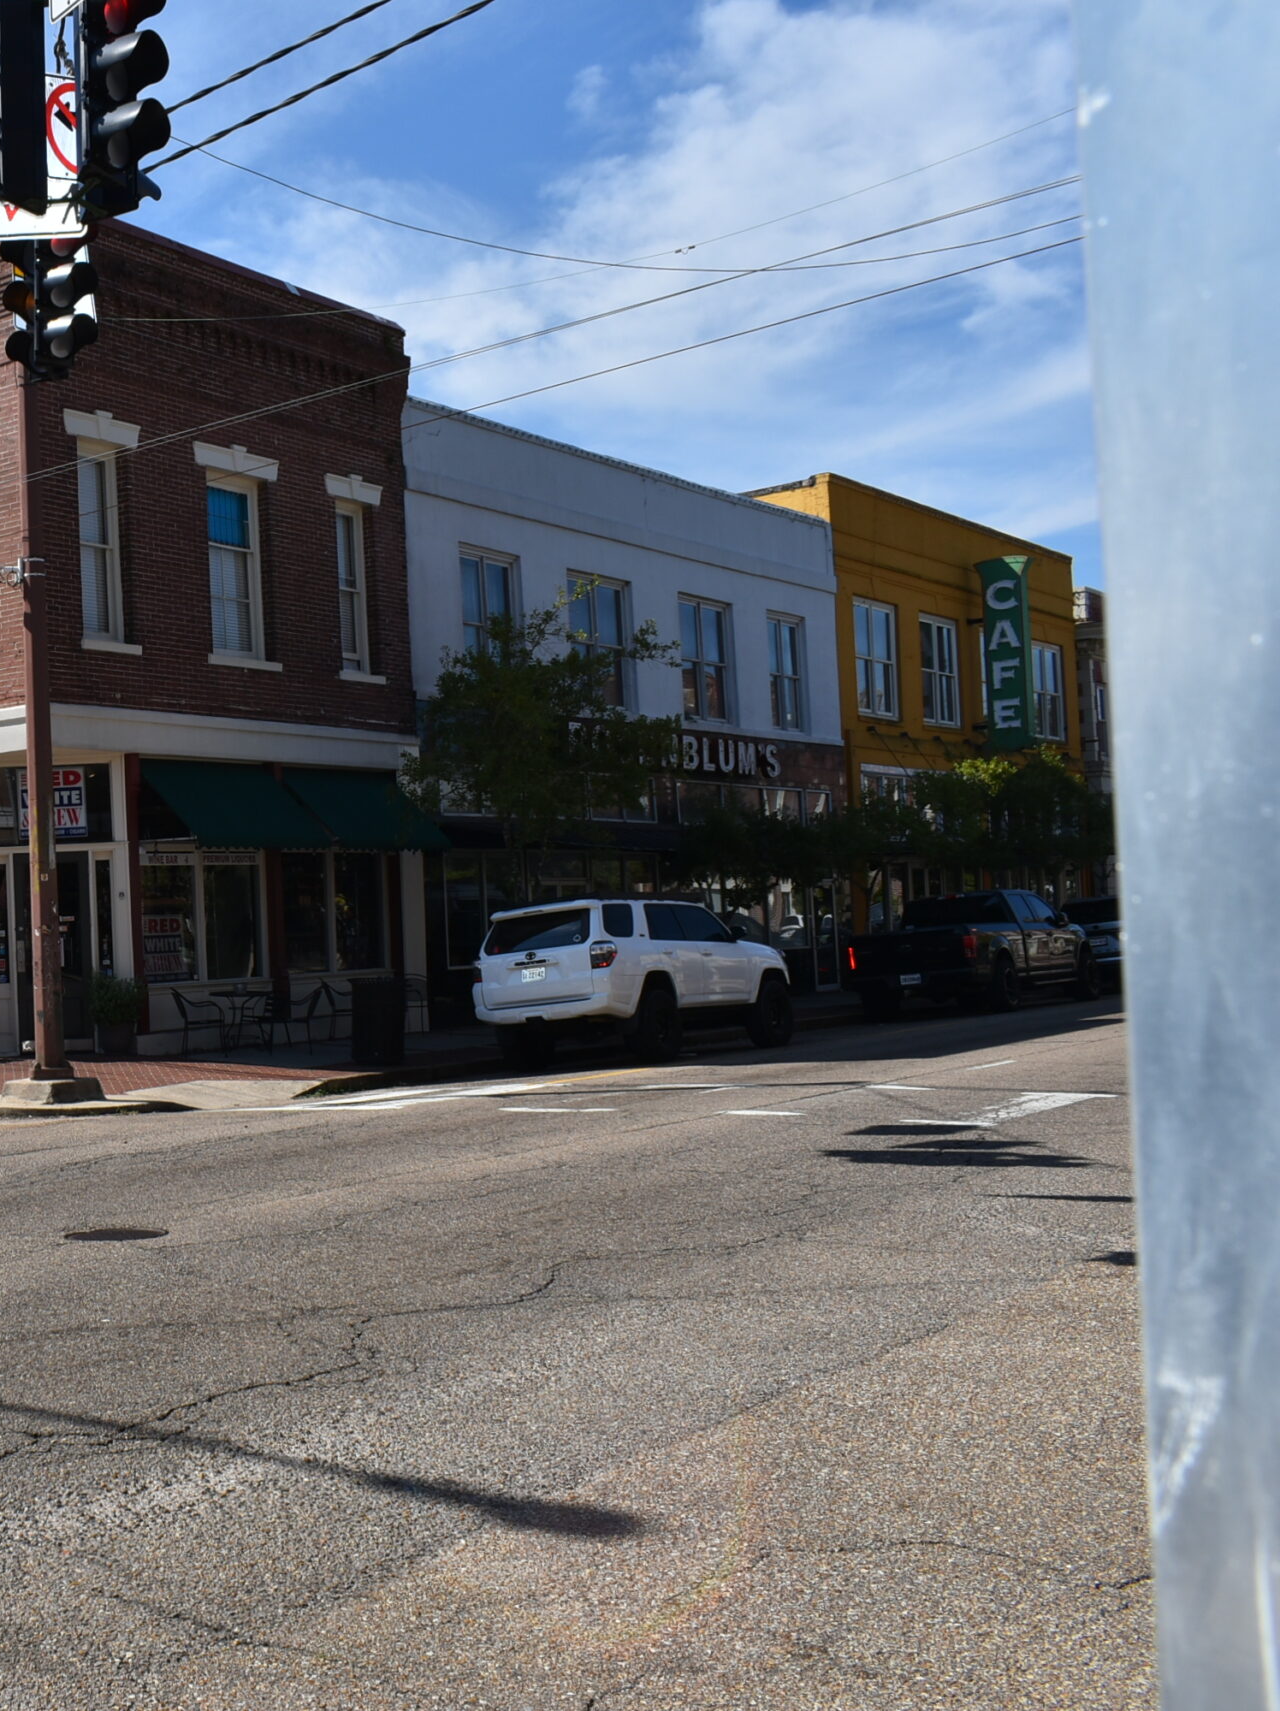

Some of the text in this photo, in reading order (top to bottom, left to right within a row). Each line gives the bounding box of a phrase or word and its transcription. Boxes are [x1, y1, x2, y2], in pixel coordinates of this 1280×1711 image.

[986, 579, 1021, 729] CAFE
[148, 918, 181, 934] RED
[144, 937, 181, 953] WHITE
